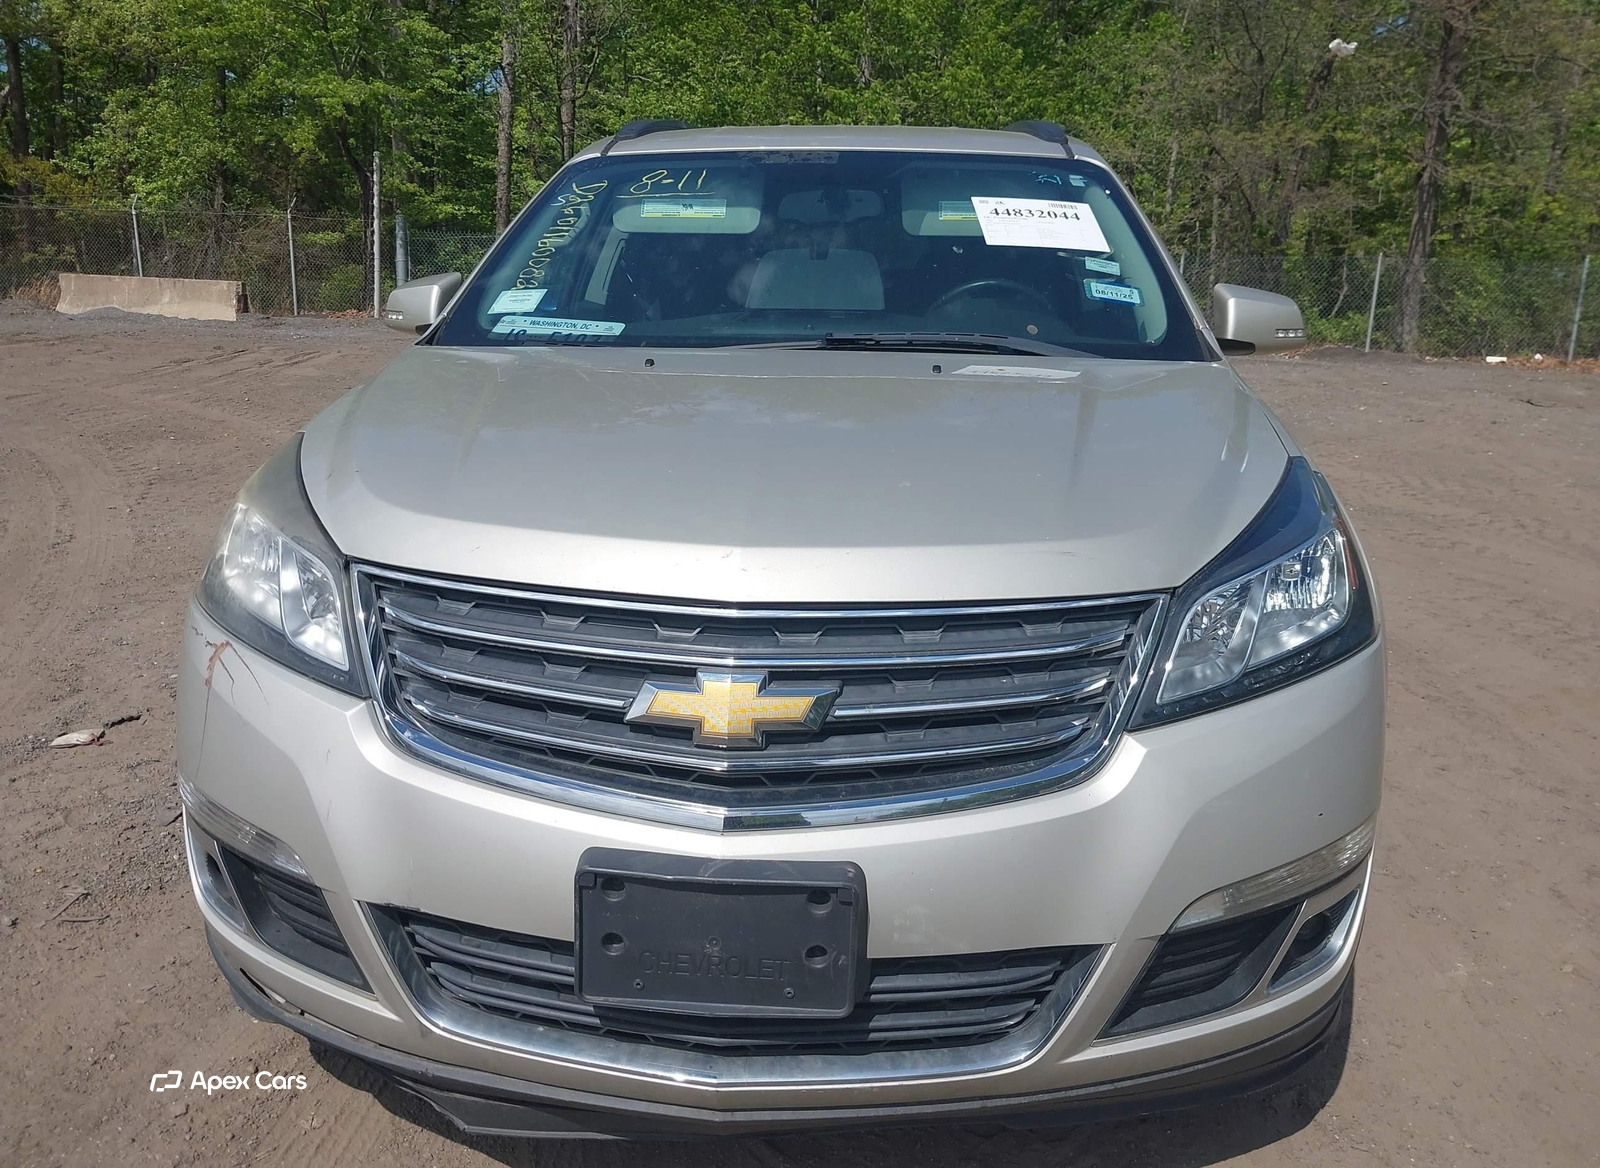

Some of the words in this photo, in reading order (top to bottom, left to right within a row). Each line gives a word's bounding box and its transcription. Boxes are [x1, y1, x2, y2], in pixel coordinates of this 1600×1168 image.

[630, 169, 708, 194] 8-11
[989, 207, 1081, 221] 44832044
[1095, 288, 1134, 300] 08/11/25
[529, 319, 579, 330] WASHINGTON,
[640, 952, 790, 981] CHEVROLET
